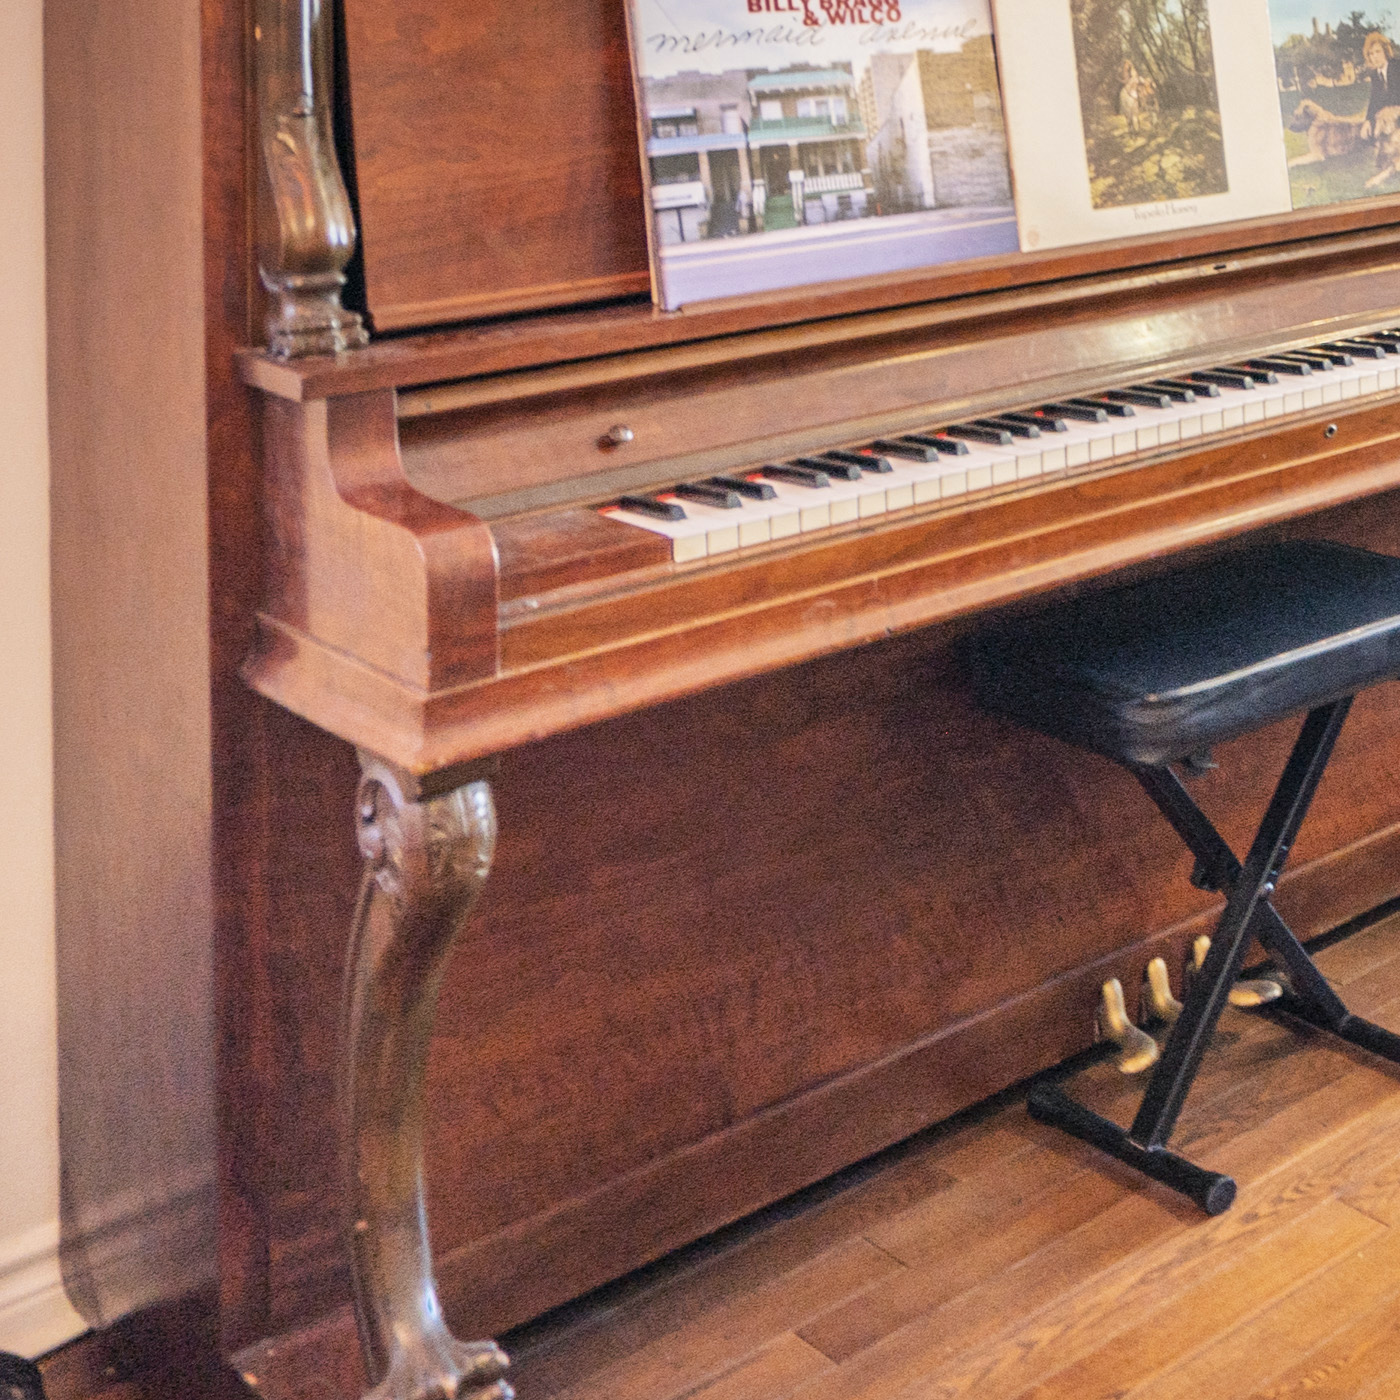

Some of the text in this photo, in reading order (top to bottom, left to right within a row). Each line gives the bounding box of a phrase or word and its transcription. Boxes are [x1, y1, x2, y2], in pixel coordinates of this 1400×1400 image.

[803, 6, 901, 27] & WILCO
[646, 17, 978, 53] mermaid avenue
